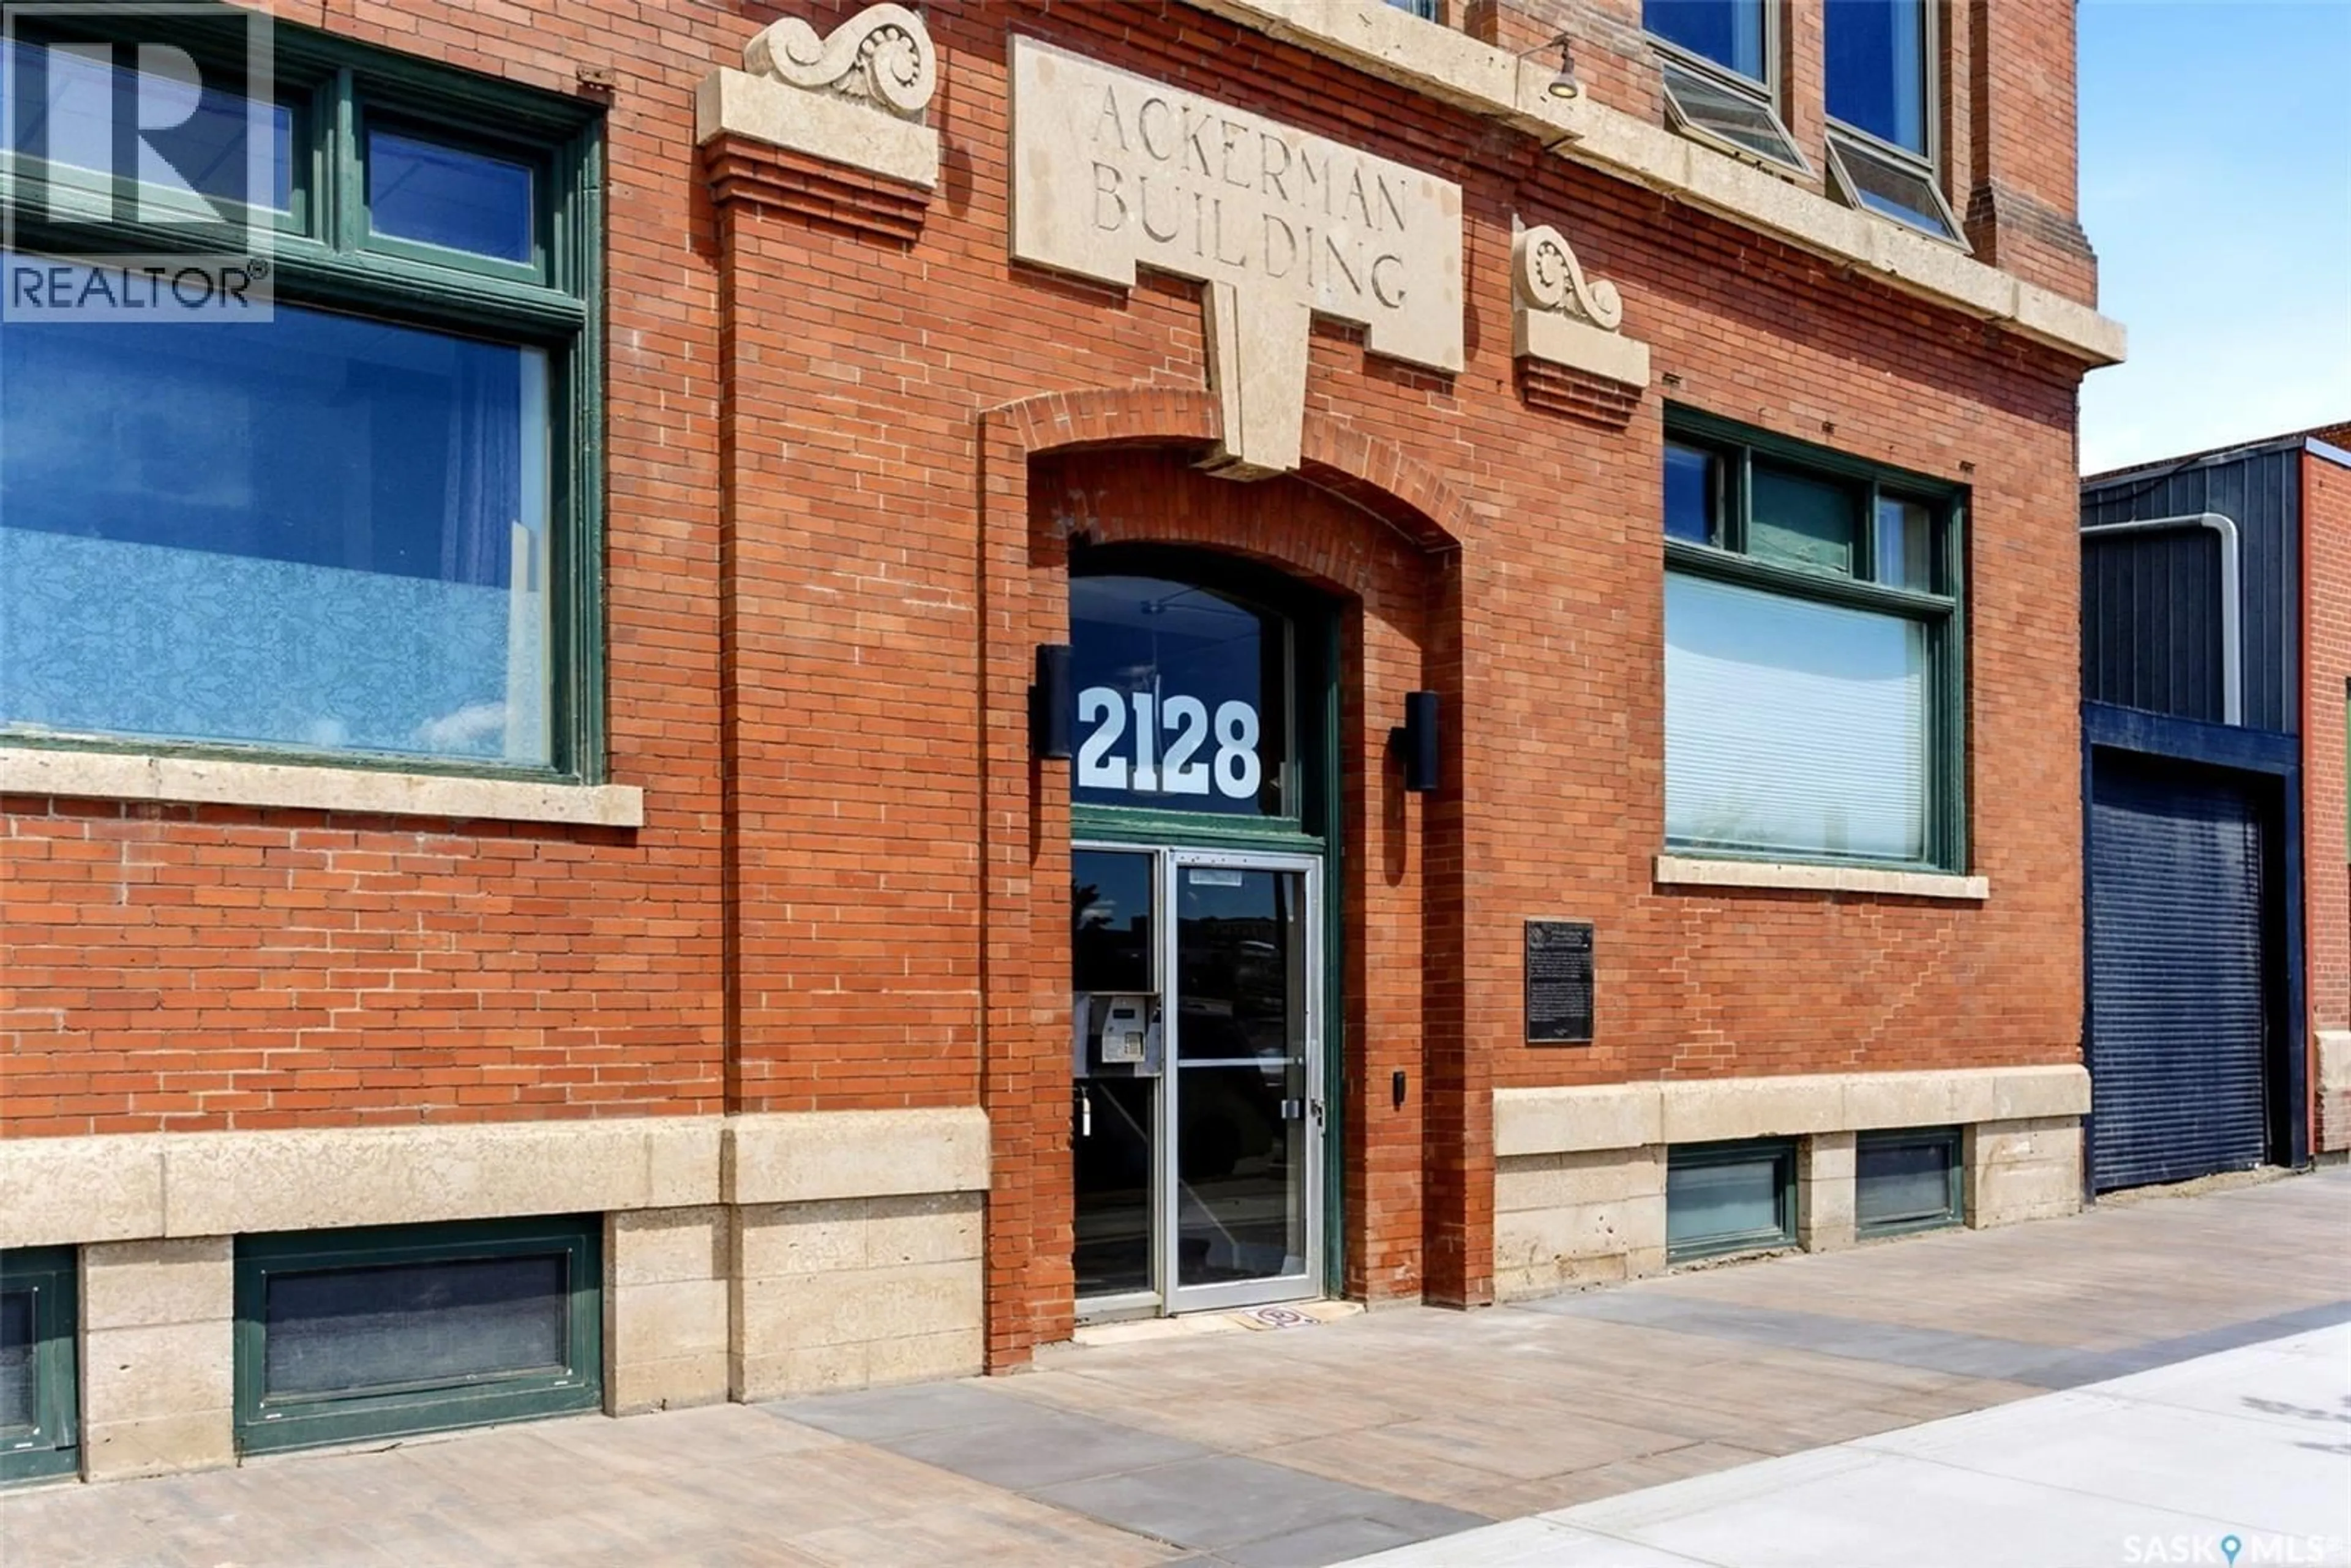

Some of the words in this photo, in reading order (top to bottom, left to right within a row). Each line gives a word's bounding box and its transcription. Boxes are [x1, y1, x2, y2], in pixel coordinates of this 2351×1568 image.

[1092, 84, 1407, 232] ACKERMAN
[1091, 160, 1406, 309] BUILDING
[1078, 686, 1261, 799] 2128
